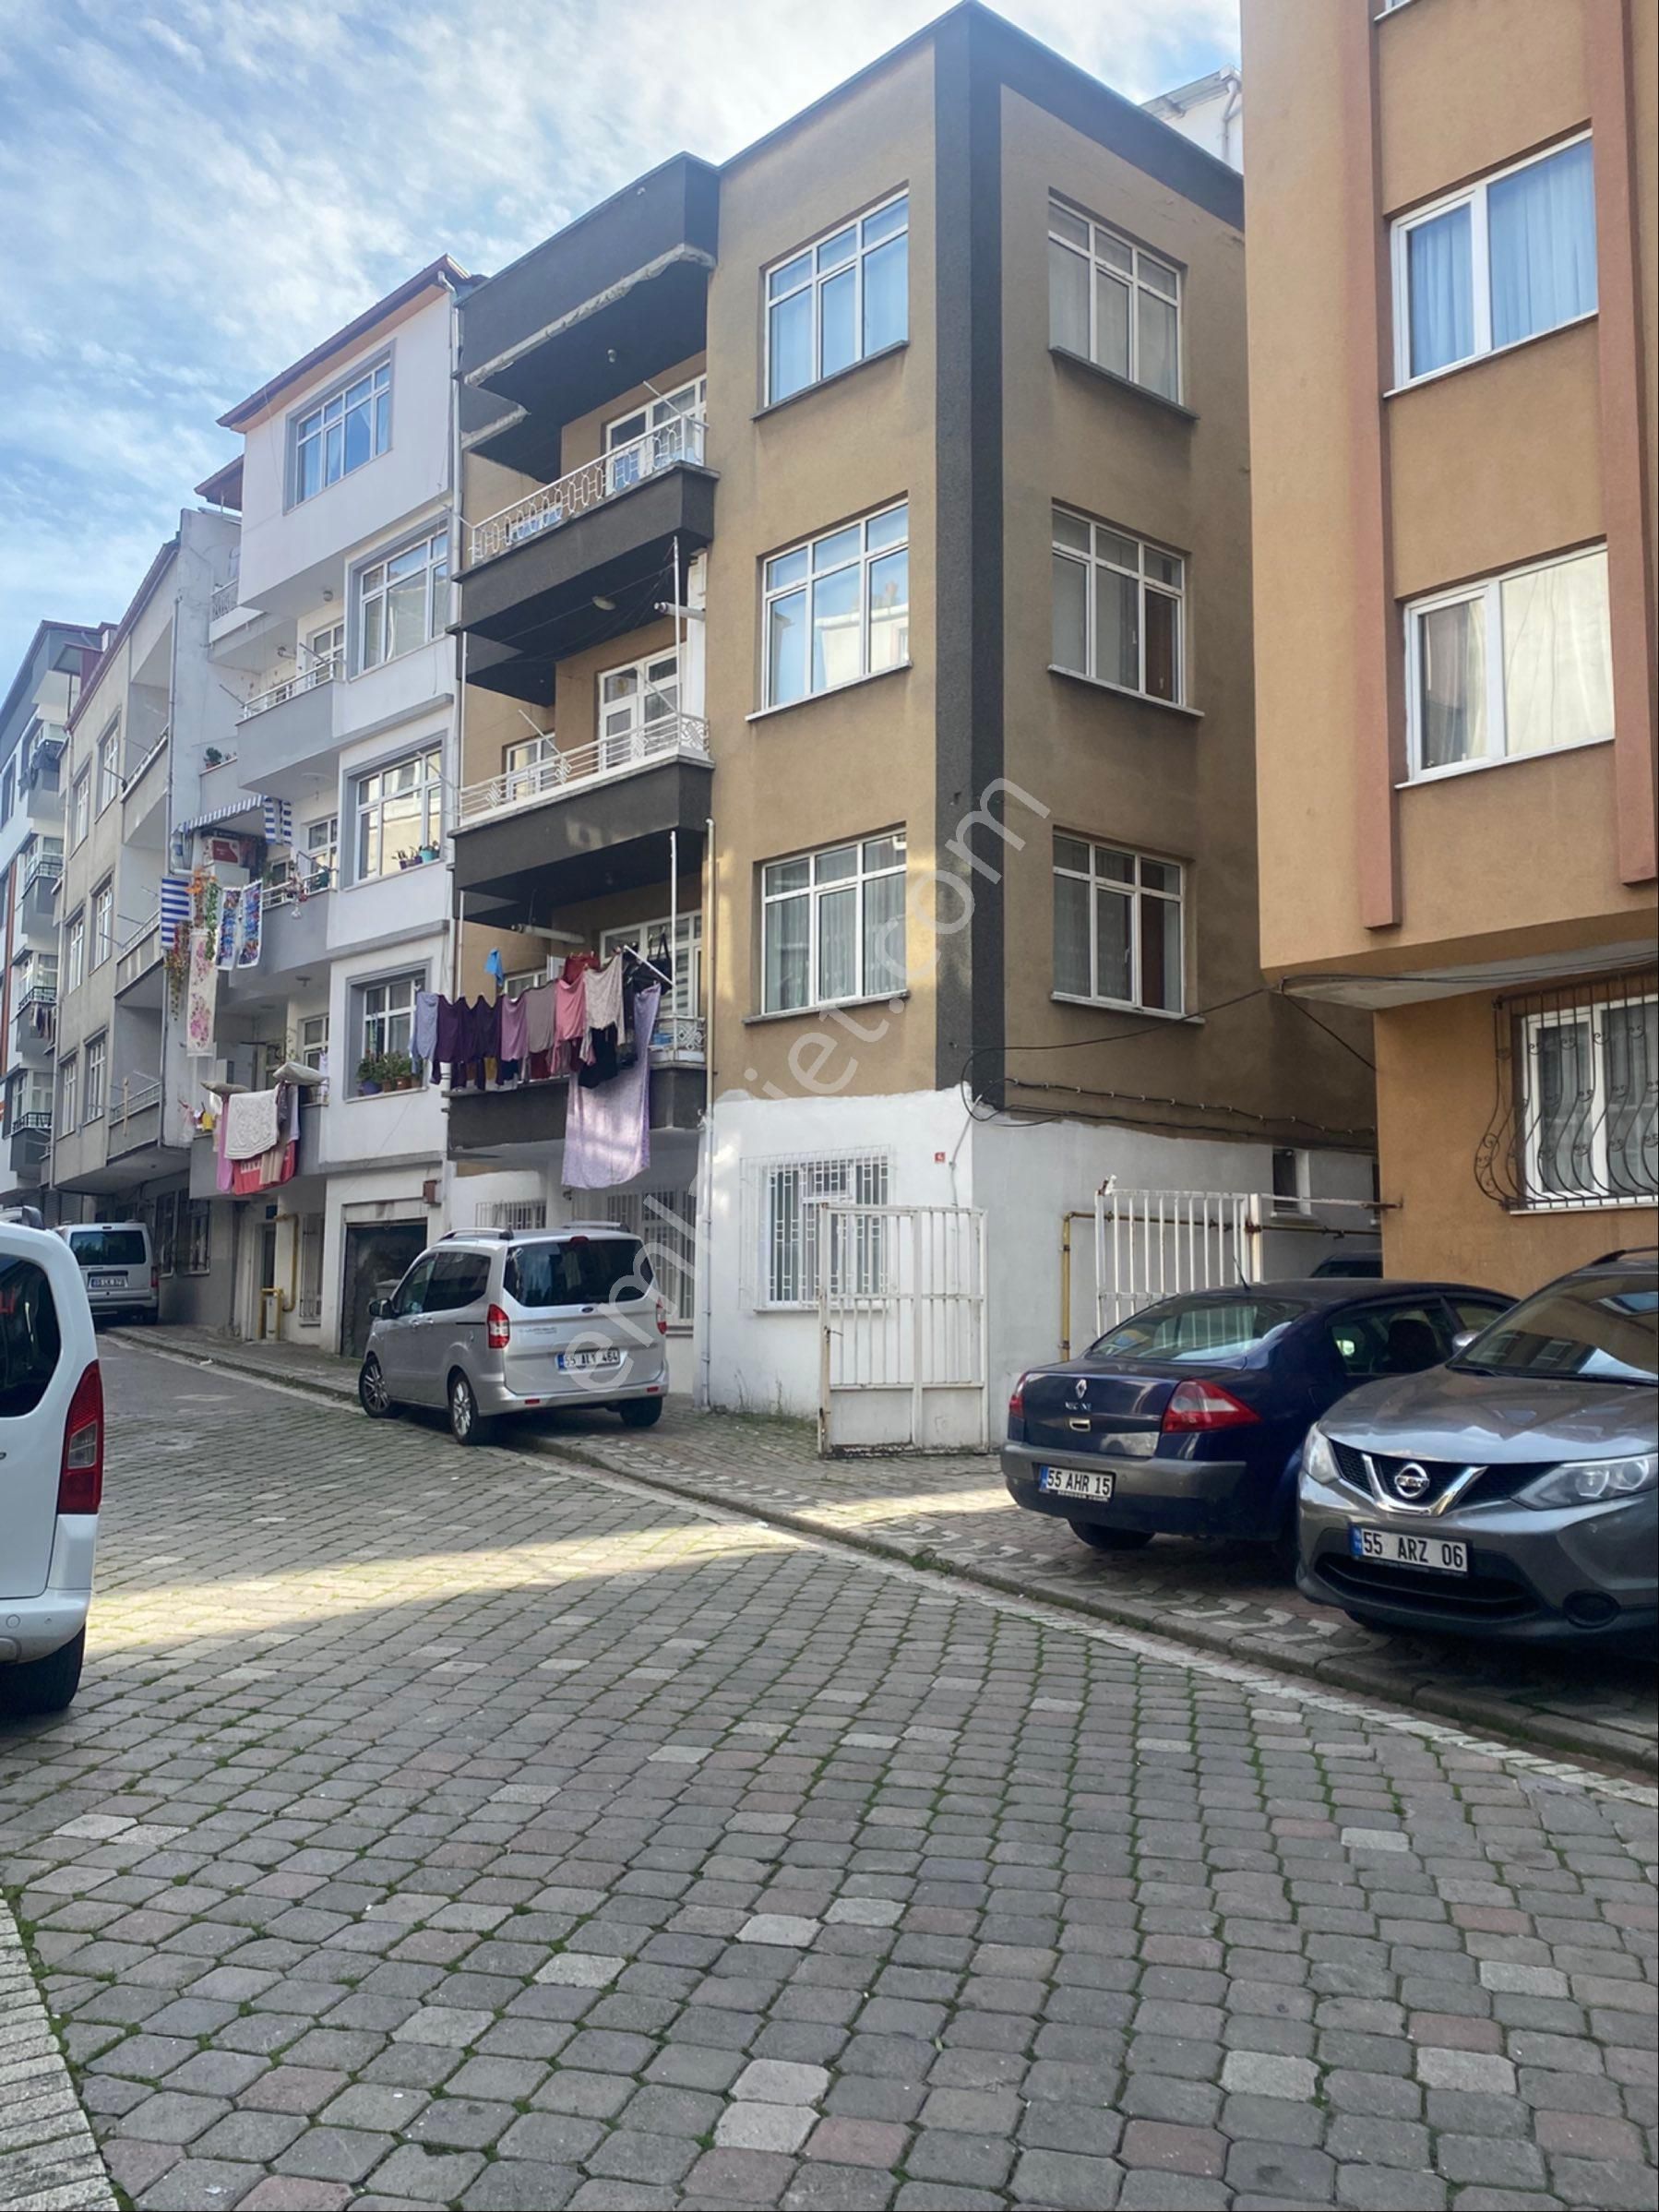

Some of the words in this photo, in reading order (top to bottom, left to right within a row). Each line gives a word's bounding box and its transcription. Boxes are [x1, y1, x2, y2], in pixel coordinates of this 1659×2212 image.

[1047, 1470, 1062, 1488] 55
[1066, 1473, 1089, 1492] AHR
[1095, 1477, 1110, 1495] 15
[1364, 1532, 1382, 1555] 55
[1398, 1536, 1428, 1562] ARZ
[1441, 1543, 1463, 1568] 06
